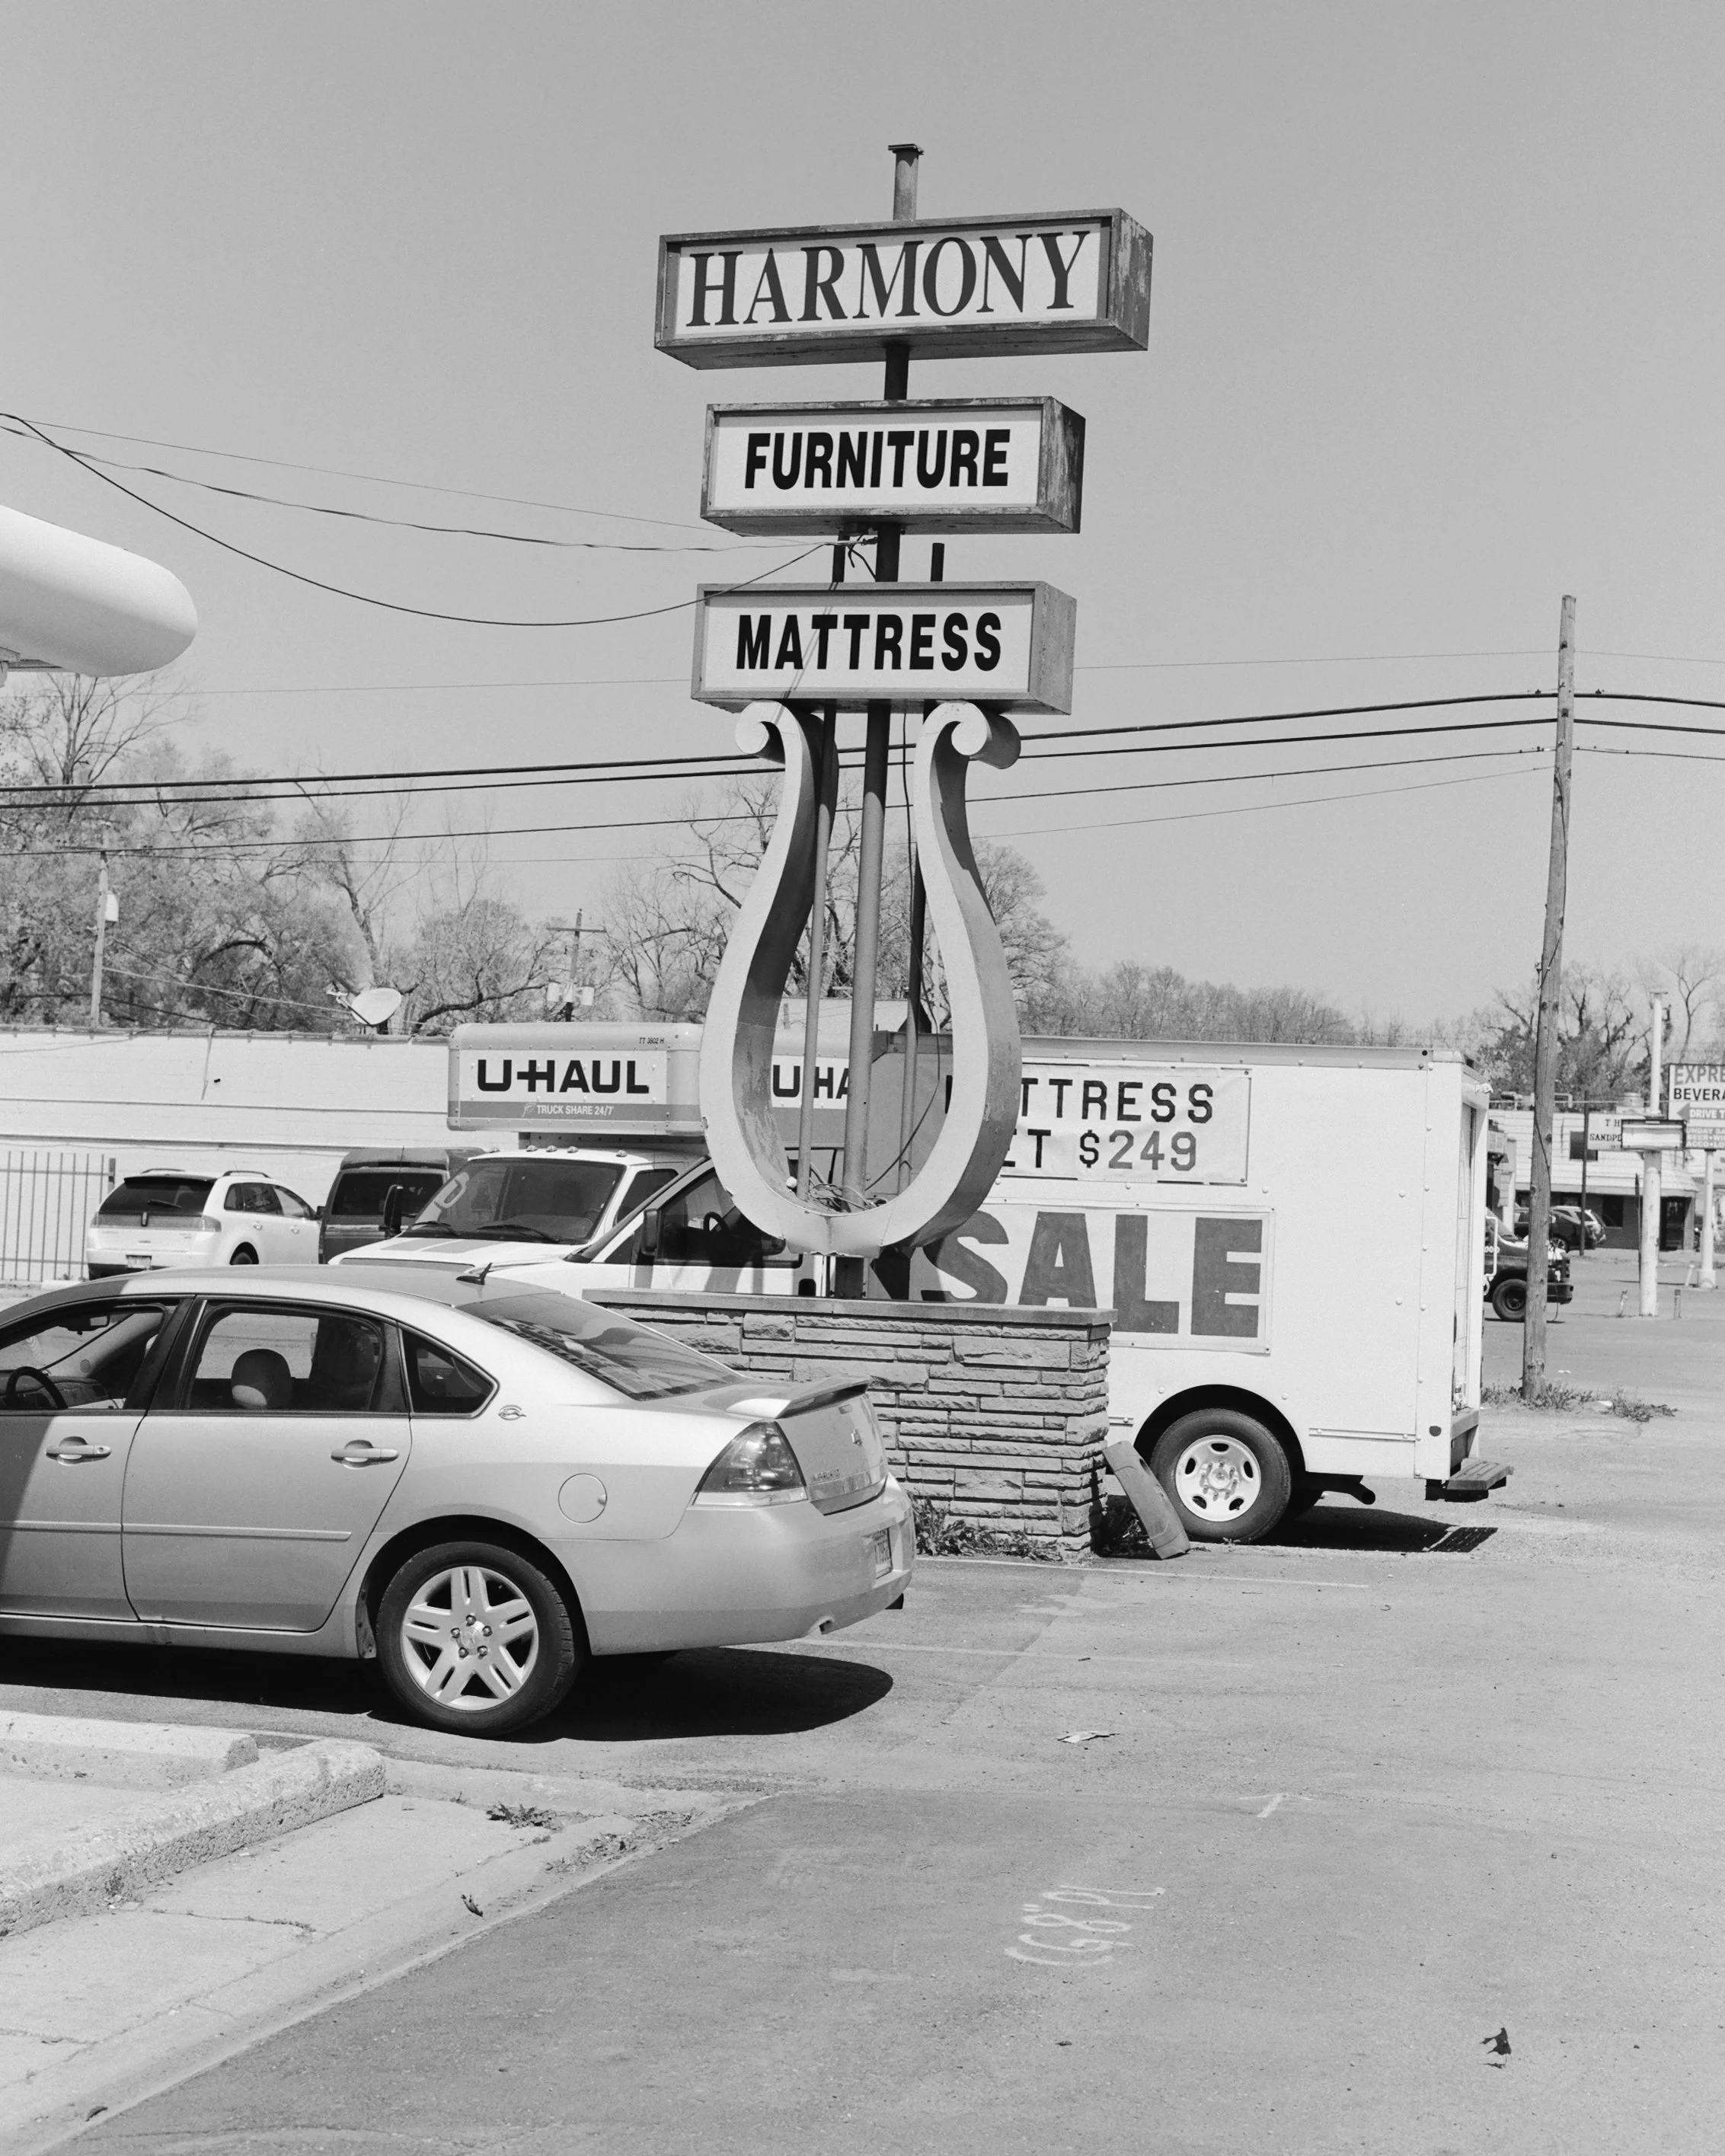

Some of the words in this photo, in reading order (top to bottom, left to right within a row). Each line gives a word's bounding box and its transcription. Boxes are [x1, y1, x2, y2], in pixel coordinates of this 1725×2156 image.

[685, 231, 1091, 327] HARMONY
[744, 429, 1011, 490] FURNITURE
[736, 612, 1001, 671] MATTRESS
[478, 1059, 650, 1094] U-HAUL
[945, 1075, 1213, 1123] TTRESS
[536, 1104, 564, 1115] TRUCK
[565, 1105, 593, 1115] SHARE
[594, 1106, 615, 1116] 24/7
[1690, 1109, 1717, 1119] DRIVE
[1079, 1129, 1197, 1171] $249
[922, 1209, 1263, 1338] SALE
